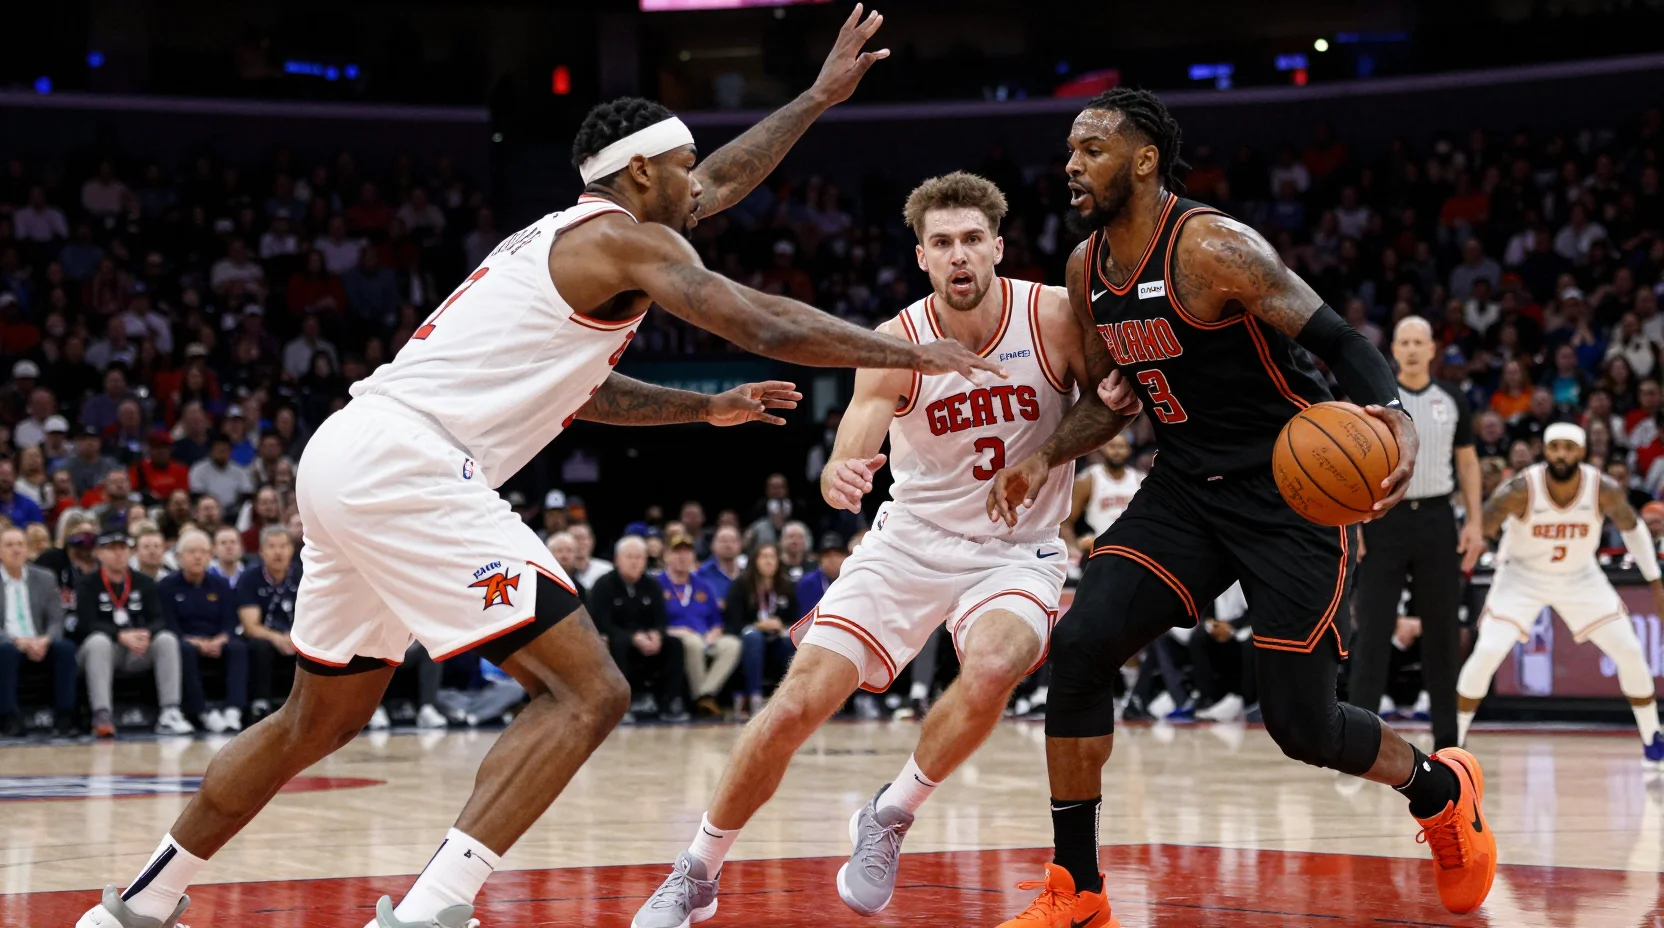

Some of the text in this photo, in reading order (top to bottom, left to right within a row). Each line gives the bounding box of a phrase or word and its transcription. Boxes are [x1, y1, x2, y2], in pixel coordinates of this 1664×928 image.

[925, 385, 1040, 436] GEATS
[1136, 368, 1188, 424] 3
[972, 436, 1006, 481] 3
